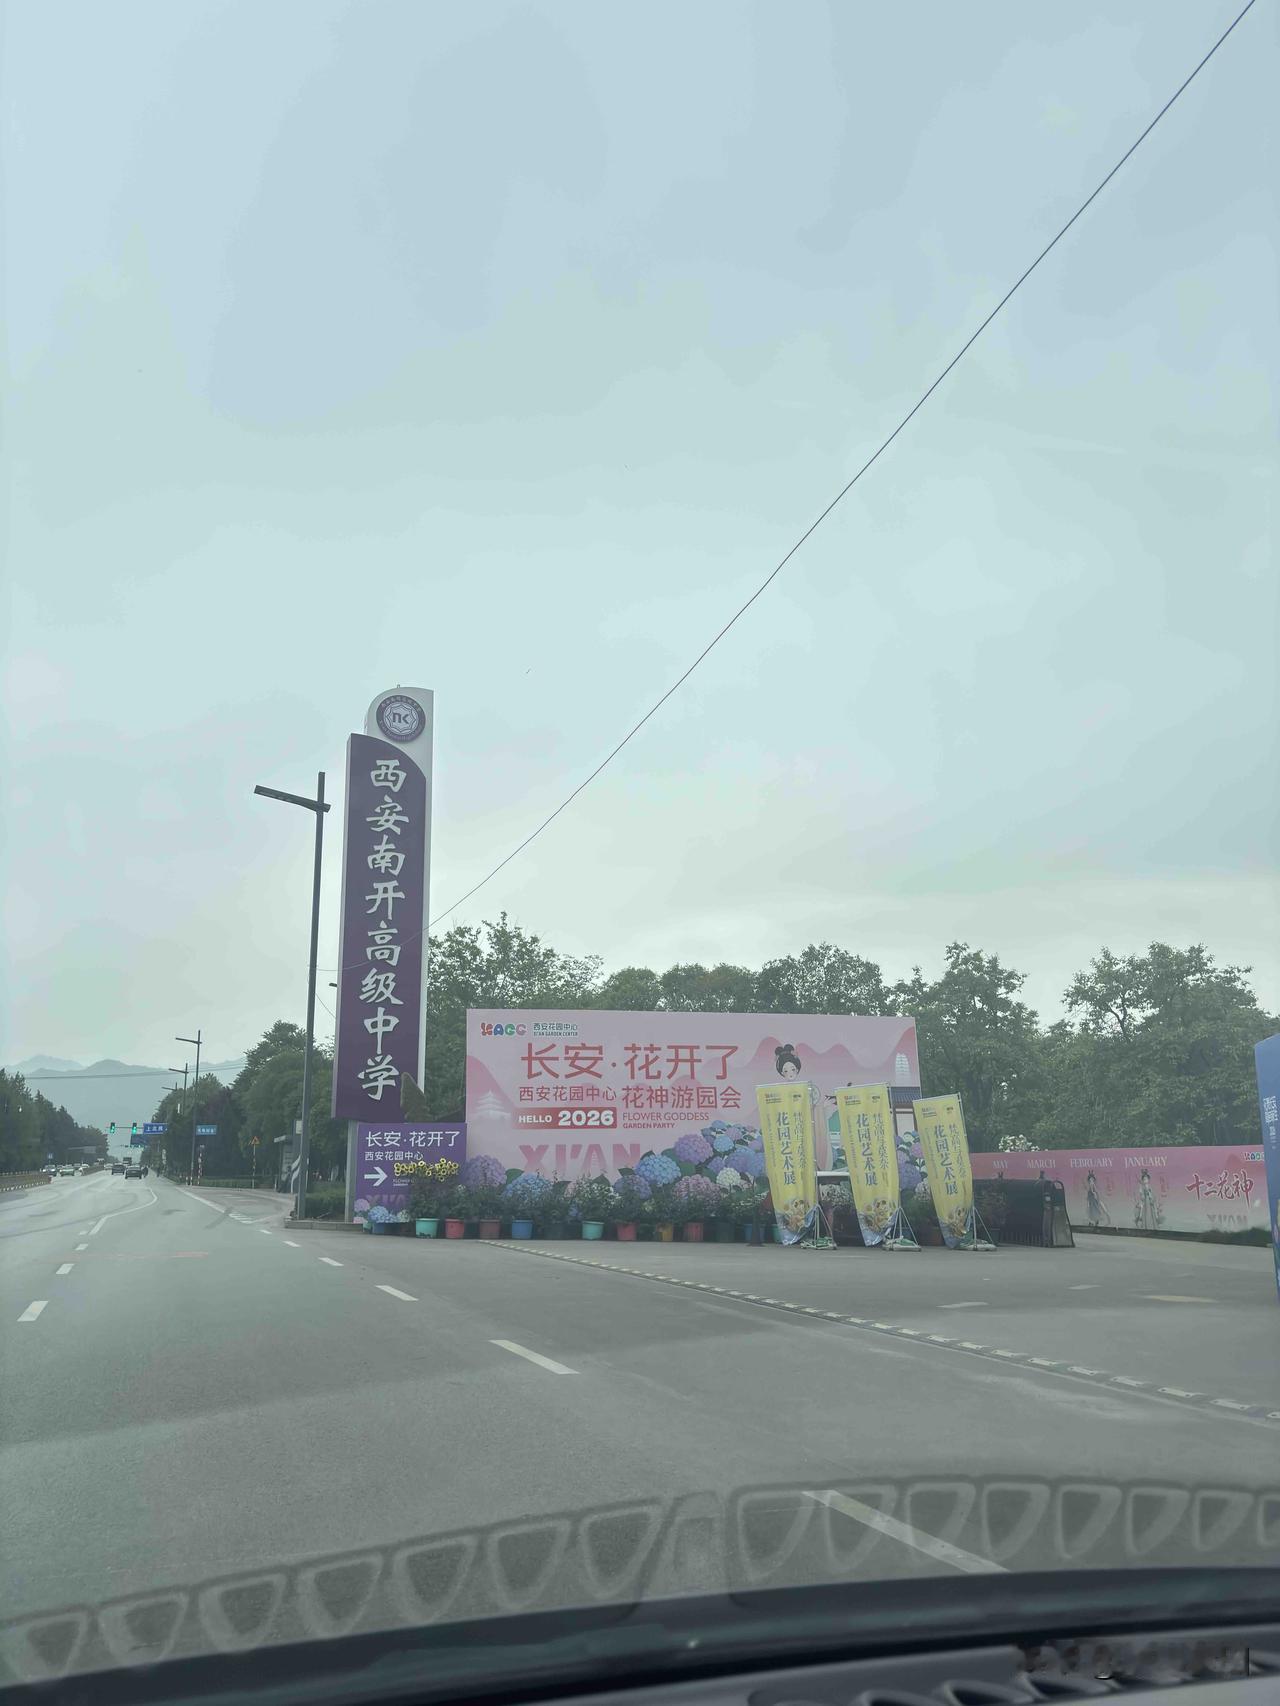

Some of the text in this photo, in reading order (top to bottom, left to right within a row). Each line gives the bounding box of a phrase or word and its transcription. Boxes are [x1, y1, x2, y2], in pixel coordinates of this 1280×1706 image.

[357, 759, 409, 1100] 西安南开高级中学
[533, 1022, 578, 1031] 西安花园中心
[521, 1042, 739, 1080] 长安·花开了
[519, 1086, 617, 1102] 西安花园中心
[622, 1086, 742, 1109] 花神游园会
[518, 1110, 614, 1126] HELLO 2026
[623, 1112, 709, 1121] FLOWER GODDESS
[365, 1131, 460, 1147] 长安·花开了
[364, 1151, 423, 1161] 西安花园中心
[776, 1111, 797, 1186] 花园艺术展
[856, 1112, 878, 1186] 花园艺术展
[934, 1124, 958, 1196] 花园艺术展
[993, 1160, 1009, 1169] MAY
[1027, 1159, 1056, 1169] MARCH
[1070, 1158, 1114, 1169] FEBRUARY
[1124, 1156, 1168, 1167] JANUARY
[1186, 1169, 1254, 1208] 十二花神
